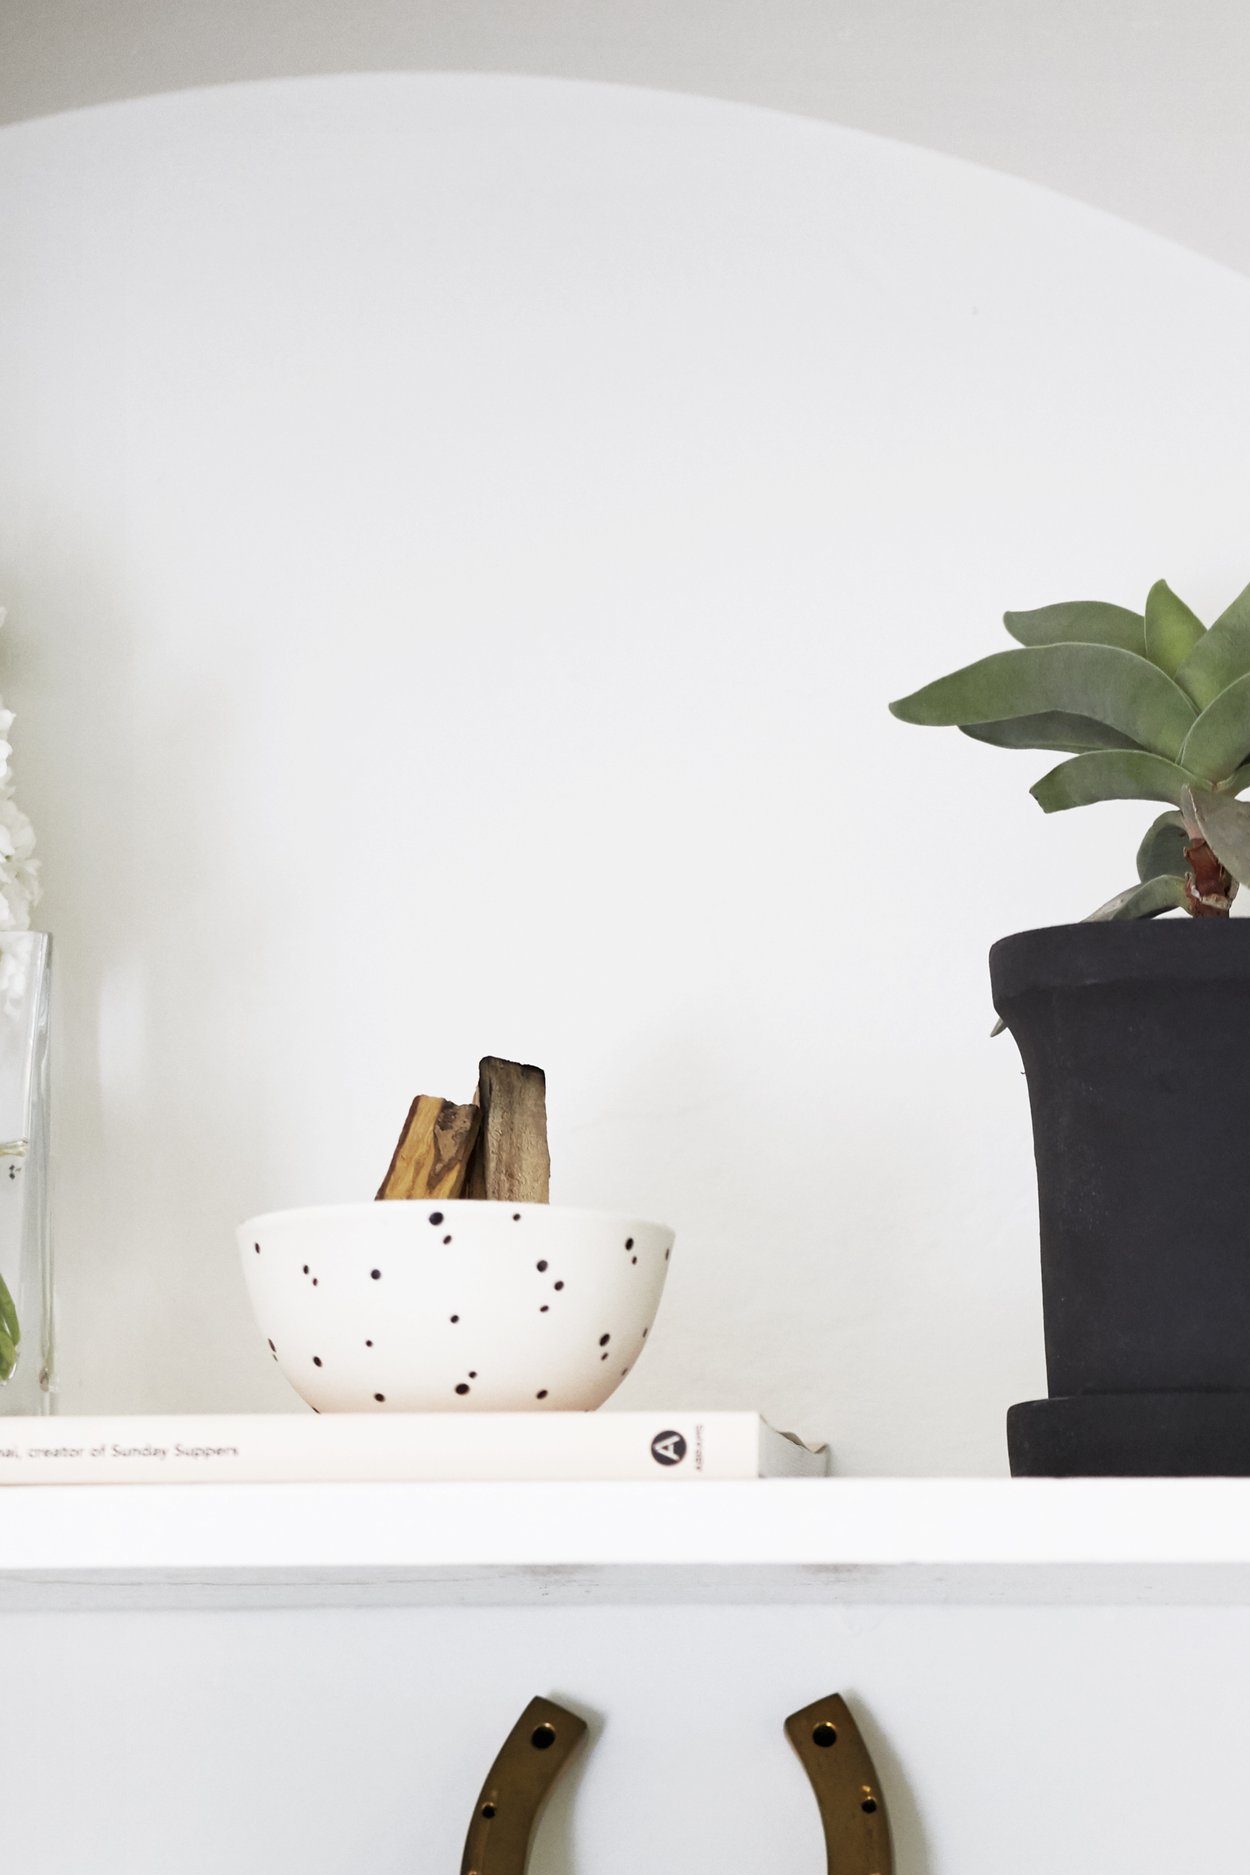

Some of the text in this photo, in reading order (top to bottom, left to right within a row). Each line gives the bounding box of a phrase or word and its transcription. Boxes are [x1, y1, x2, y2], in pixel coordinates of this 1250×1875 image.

[28, 1447, 82, 1458] creator
[91, 1444, 106, 1458] of
[112, 1444, 168, 1461] Sunday
[174, 1444, 239, 1460] Suppers
